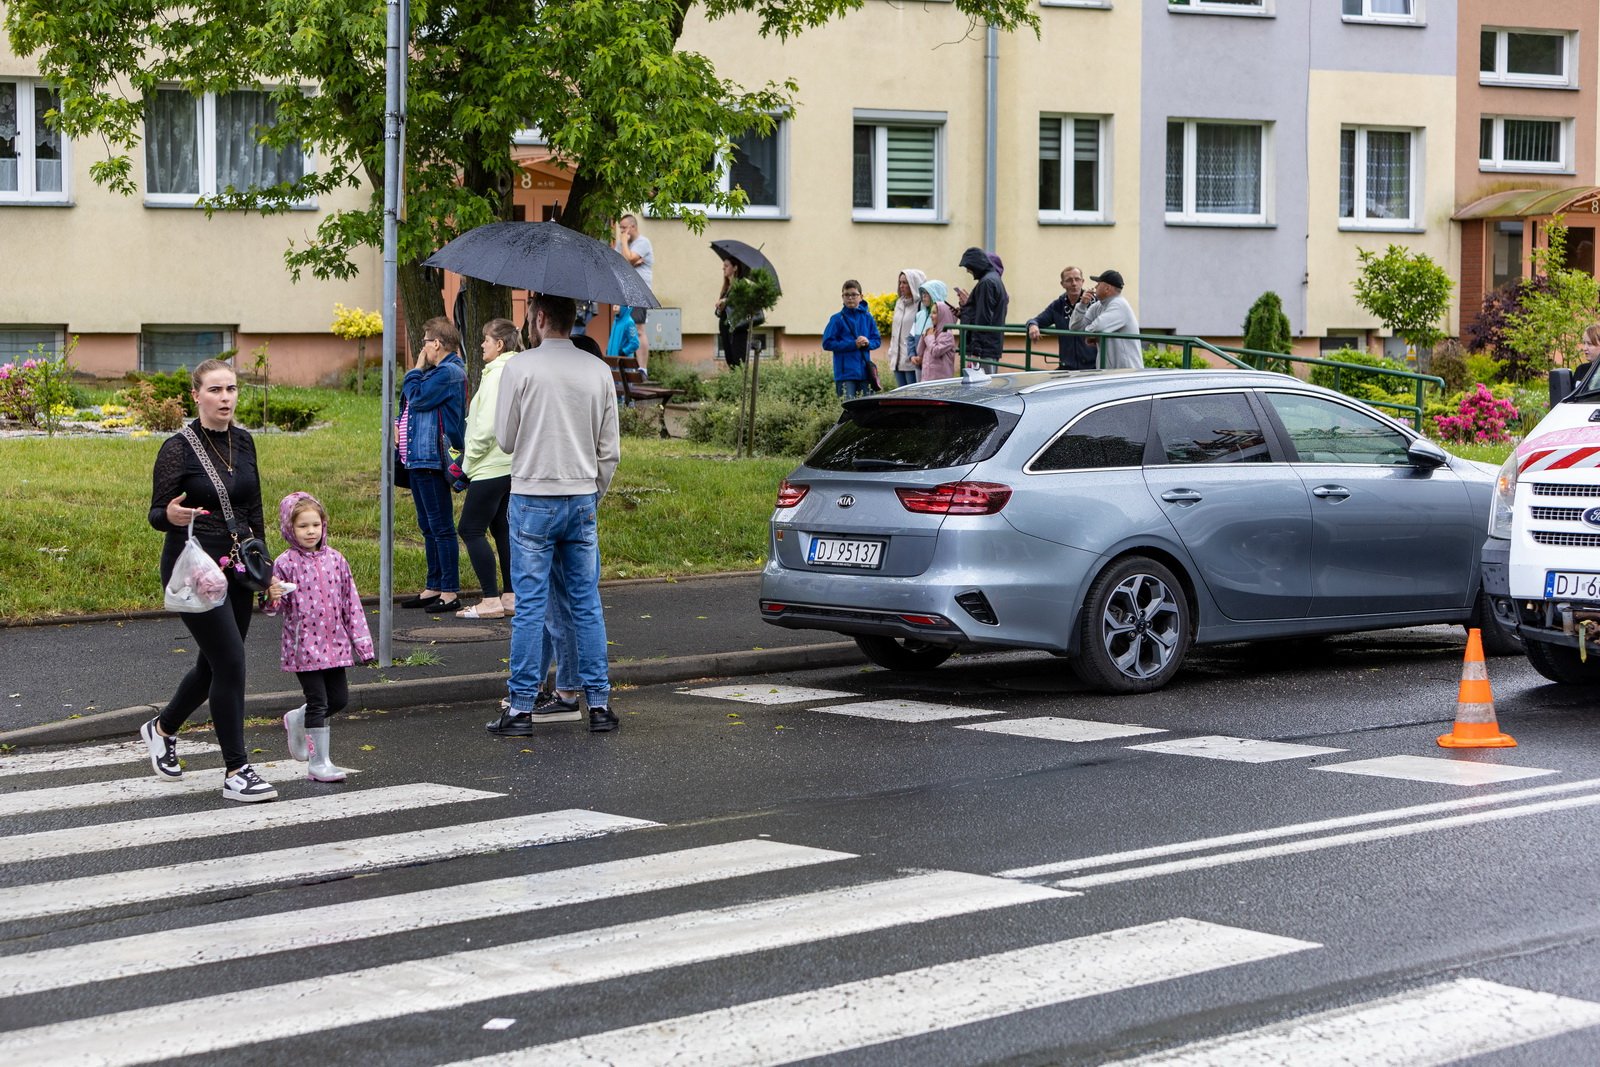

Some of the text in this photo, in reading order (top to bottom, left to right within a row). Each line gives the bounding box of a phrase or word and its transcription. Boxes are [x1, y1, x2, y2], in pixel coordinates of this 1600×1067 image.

[521, 172, 532, 189] 8
[1591, 200, 1599, 214] 8
[817, 541, 879, 563] DJ 95137
[1556, 574, 1600, 597] DJ 6
